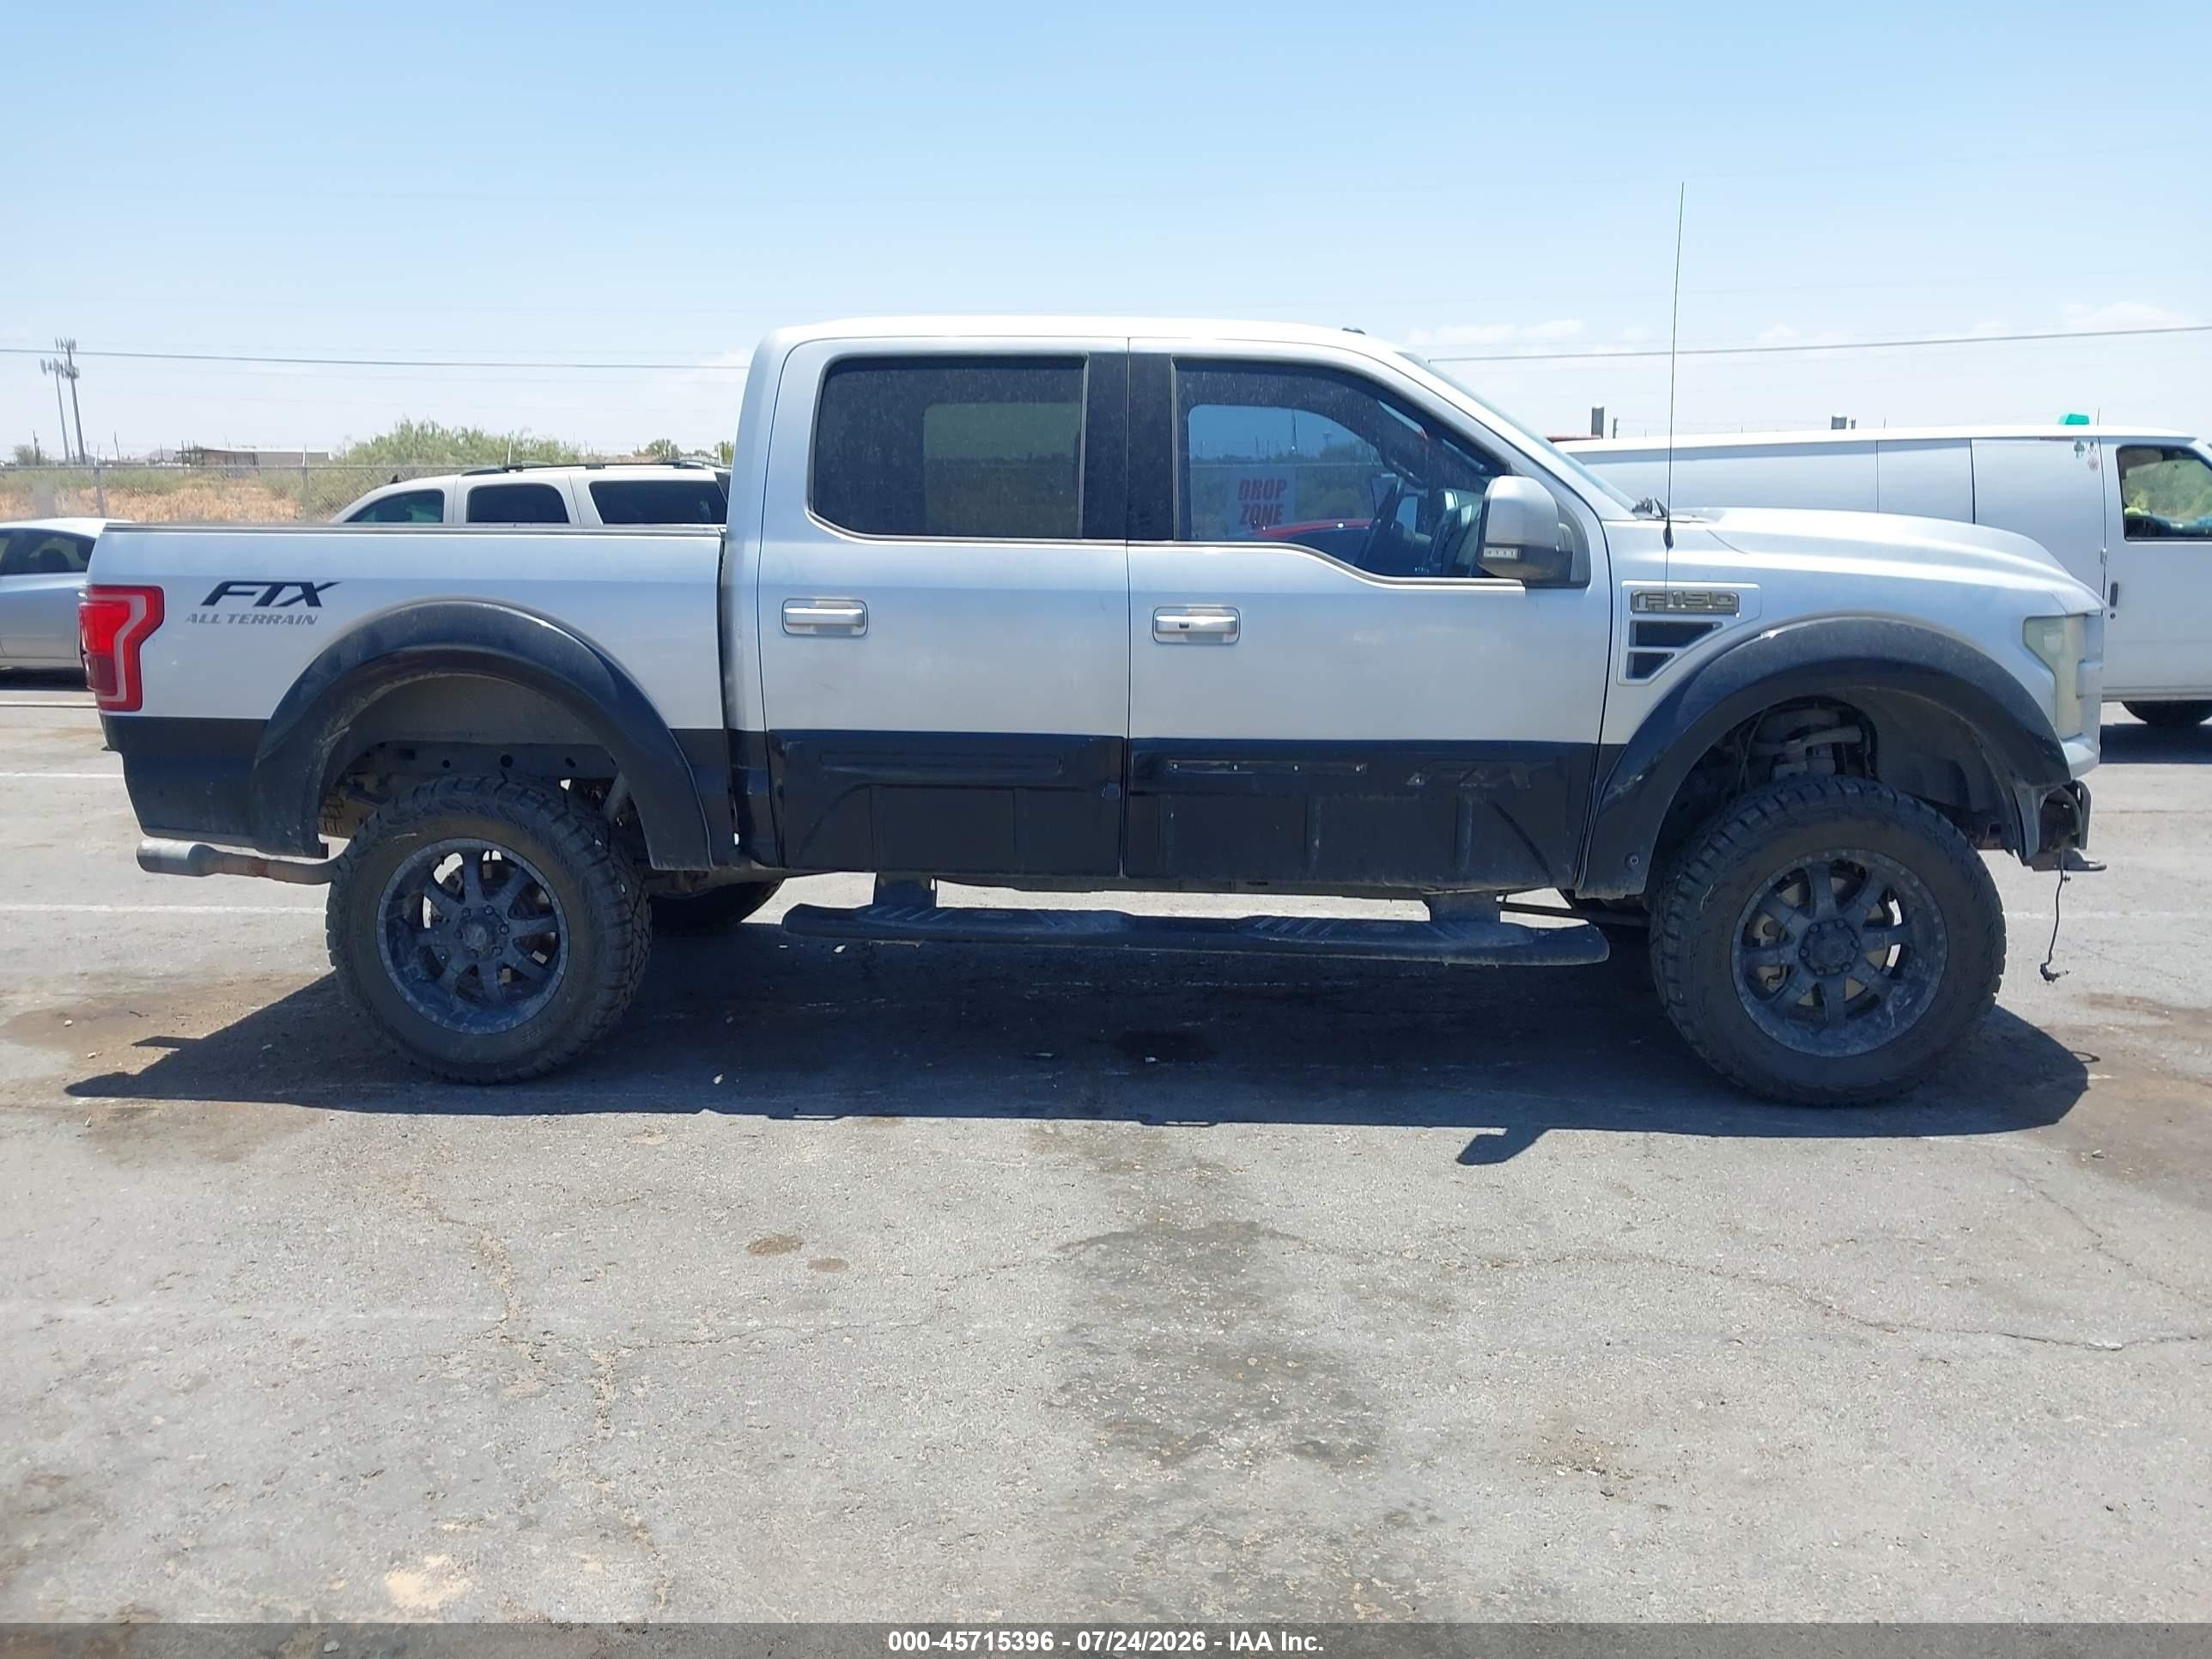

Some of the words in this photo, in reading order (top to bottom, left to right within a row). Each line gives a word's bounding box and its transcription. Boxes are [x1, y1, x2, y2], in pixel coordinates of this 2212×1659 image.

[1237, 478, 1288, 501] DROP
[1239, 503, 1285, 526] ZONE
[199, 580, 342, 607] FTX
[185, 613, 222, 624] ALL
[226, 613, 318, 625] TERRAIN
